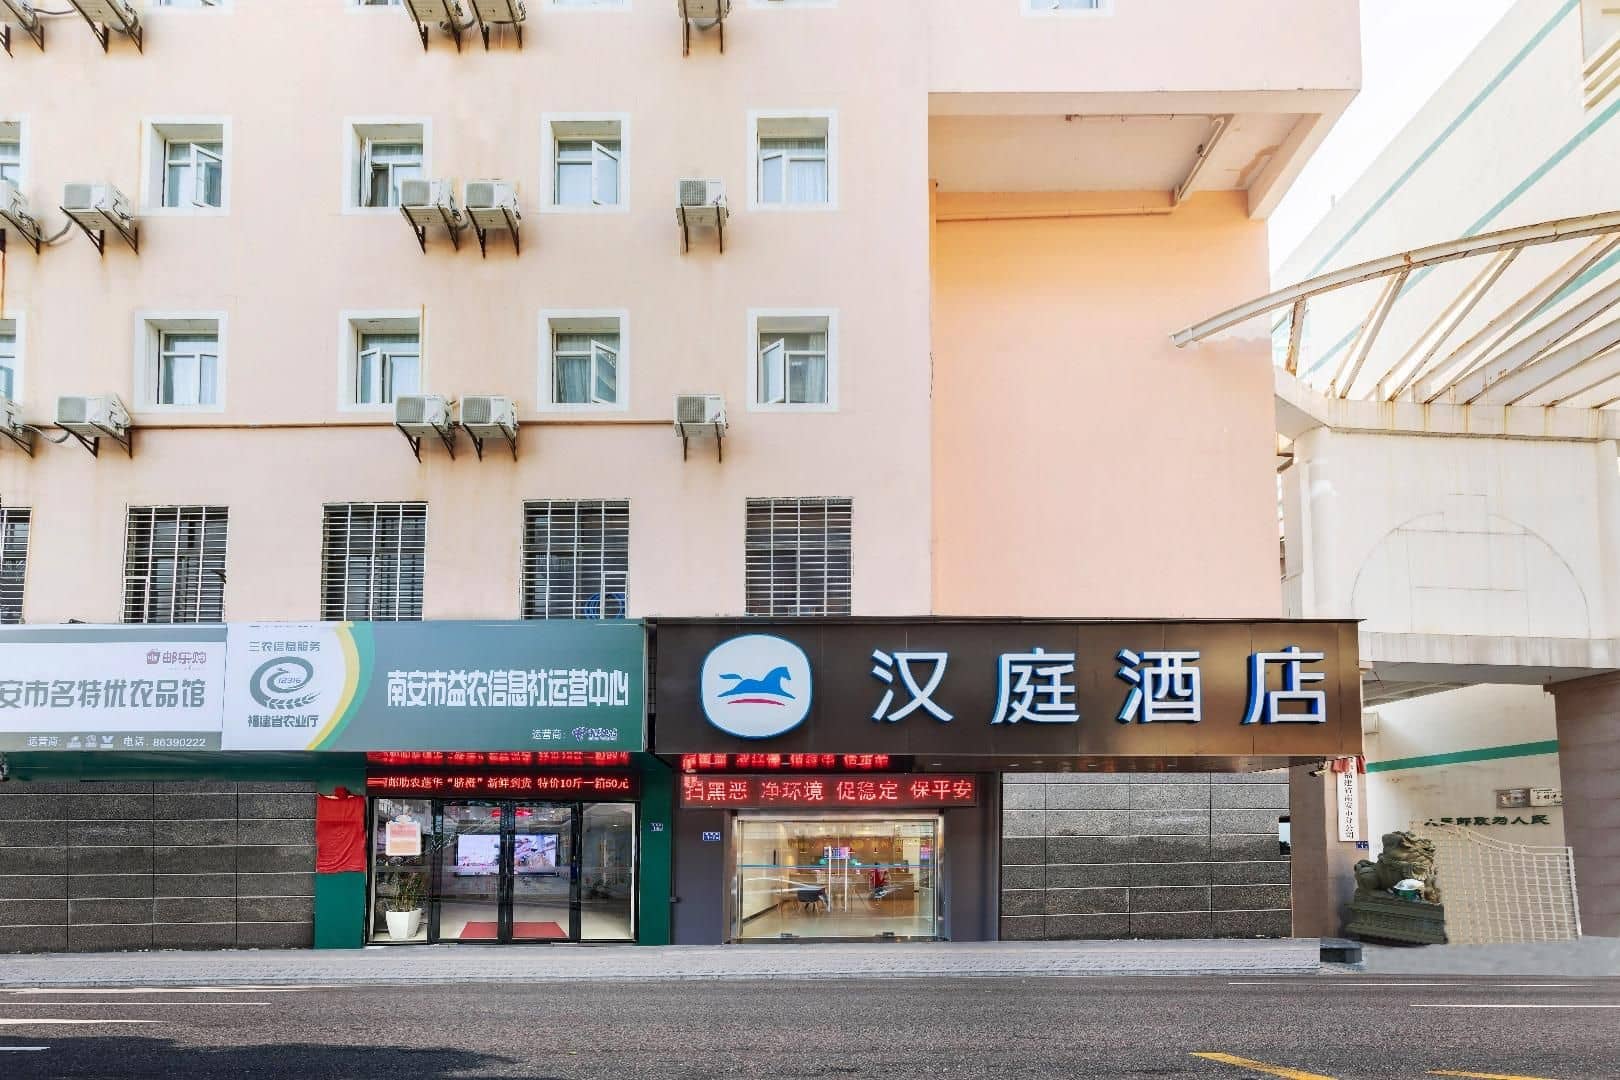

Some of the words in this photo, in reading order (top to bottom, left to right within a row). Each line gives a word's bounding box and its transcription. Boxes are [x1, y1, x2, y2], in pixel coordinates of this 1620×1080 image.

[247, 641, 320, 652] 三农信息服务
[0, 679, 206, 708] 安市名特优农品馆
[387, 669, 629, 707] 南安市益农信息社运营中心
[870, 647, 1327, 725] 汉庭酒店
[247, 714, 319, 728] 福建省农业厅
[760, 781, 824, 800] 净环境
[836, 781, 898, 800] 促稳定
[910, 780, 972, 800] 保平安
